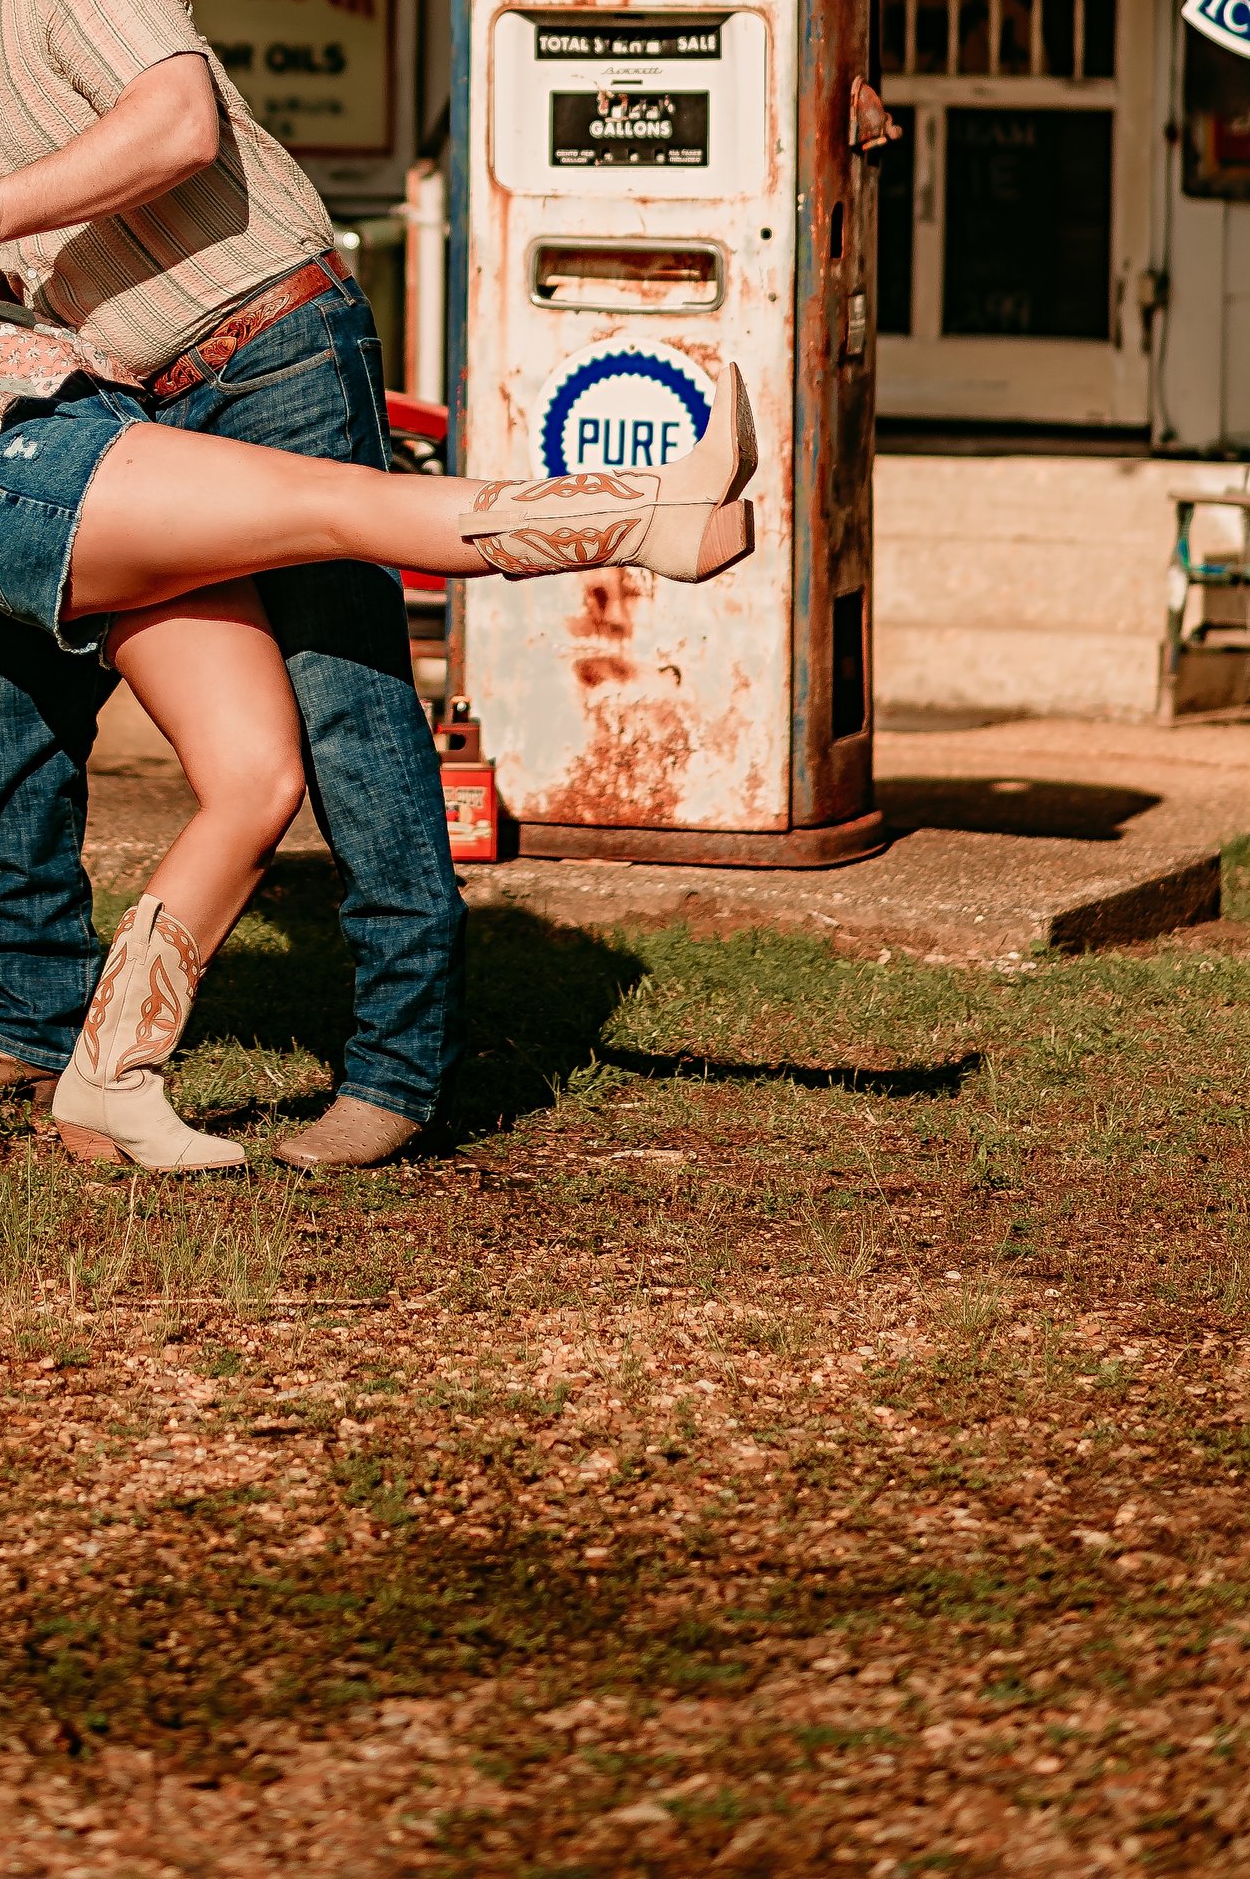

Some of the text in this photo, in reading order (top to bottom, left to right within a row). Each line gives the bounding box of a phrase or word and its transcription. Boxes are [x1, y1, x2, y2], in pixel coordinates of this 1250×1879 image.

[539, 35, 589, 53] TOTAL
[676, 34, 716, 53] SALE
[265, 40, 346, 74] OILS
[590, 120, 672, 138] GALLONS
[577, 417, 681, 467] PURE
